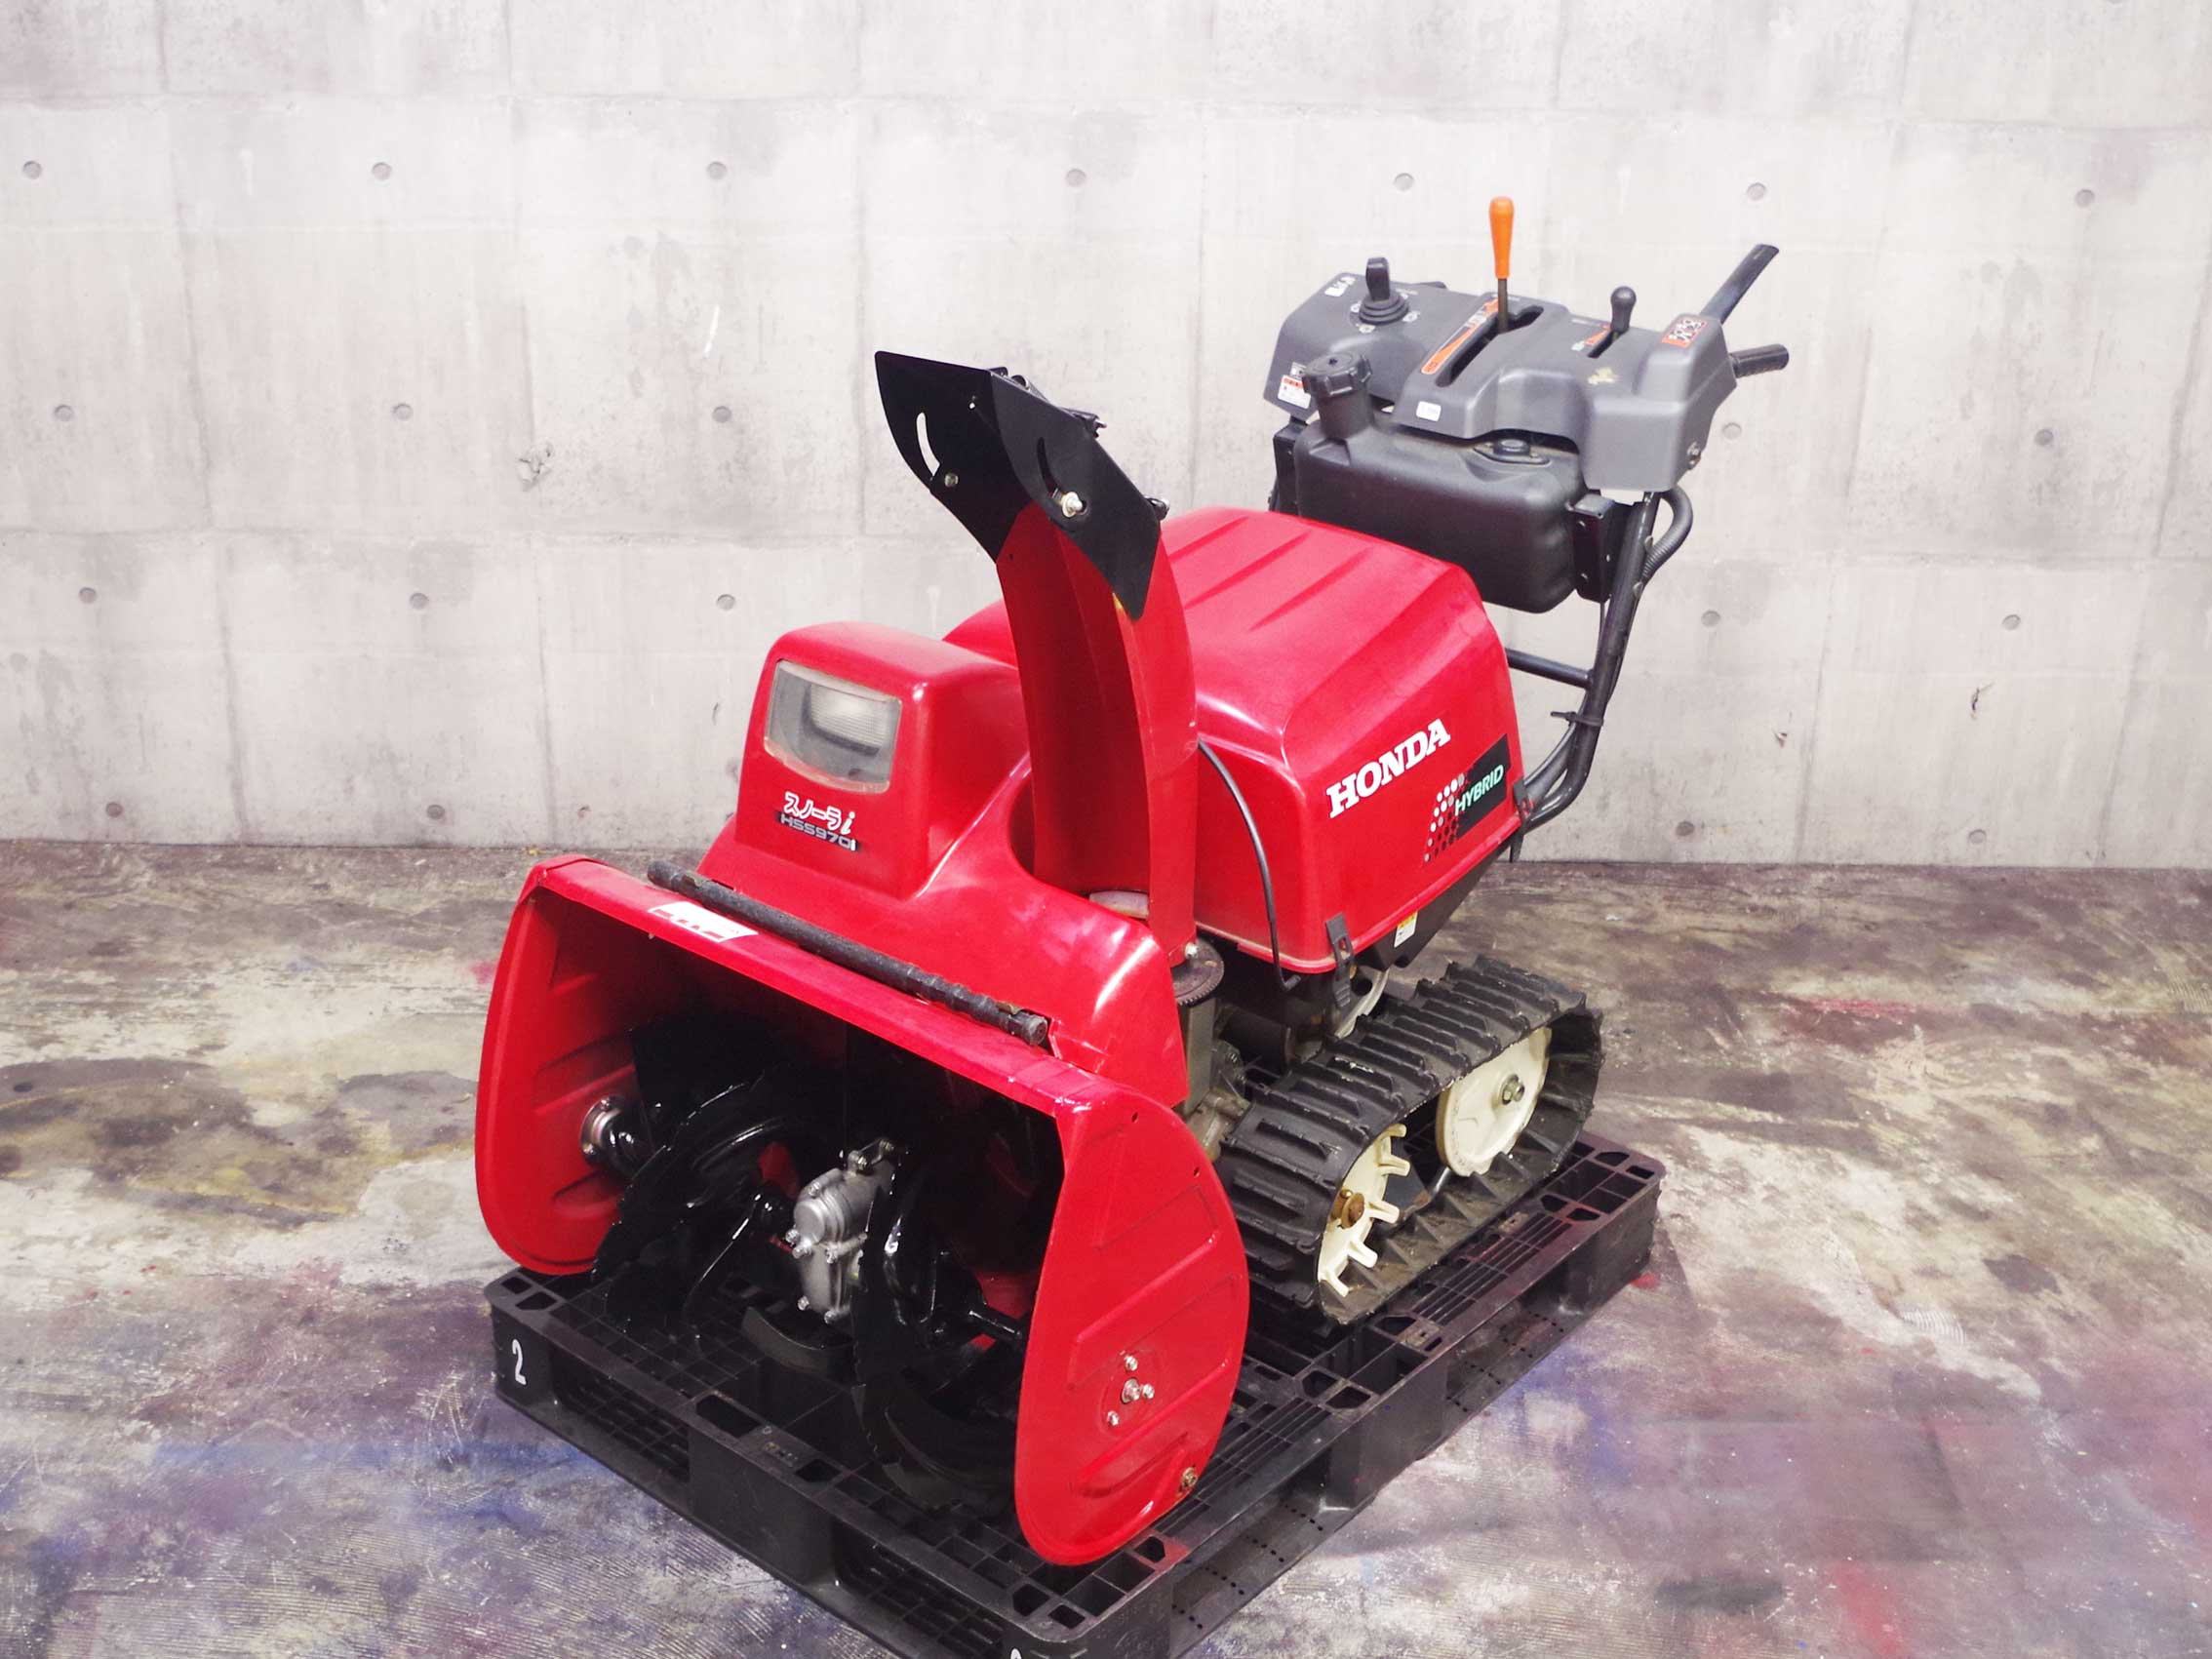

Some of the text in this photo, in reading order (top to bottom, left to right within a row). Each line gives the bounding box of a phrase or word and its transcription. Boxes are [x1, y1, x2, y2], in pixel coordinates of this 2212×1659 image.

[1326, 719, 1451, 818] HONDA
[1455, 765, 1505, 816] HYBRID
[512, 1339, 527, 1385] 2
